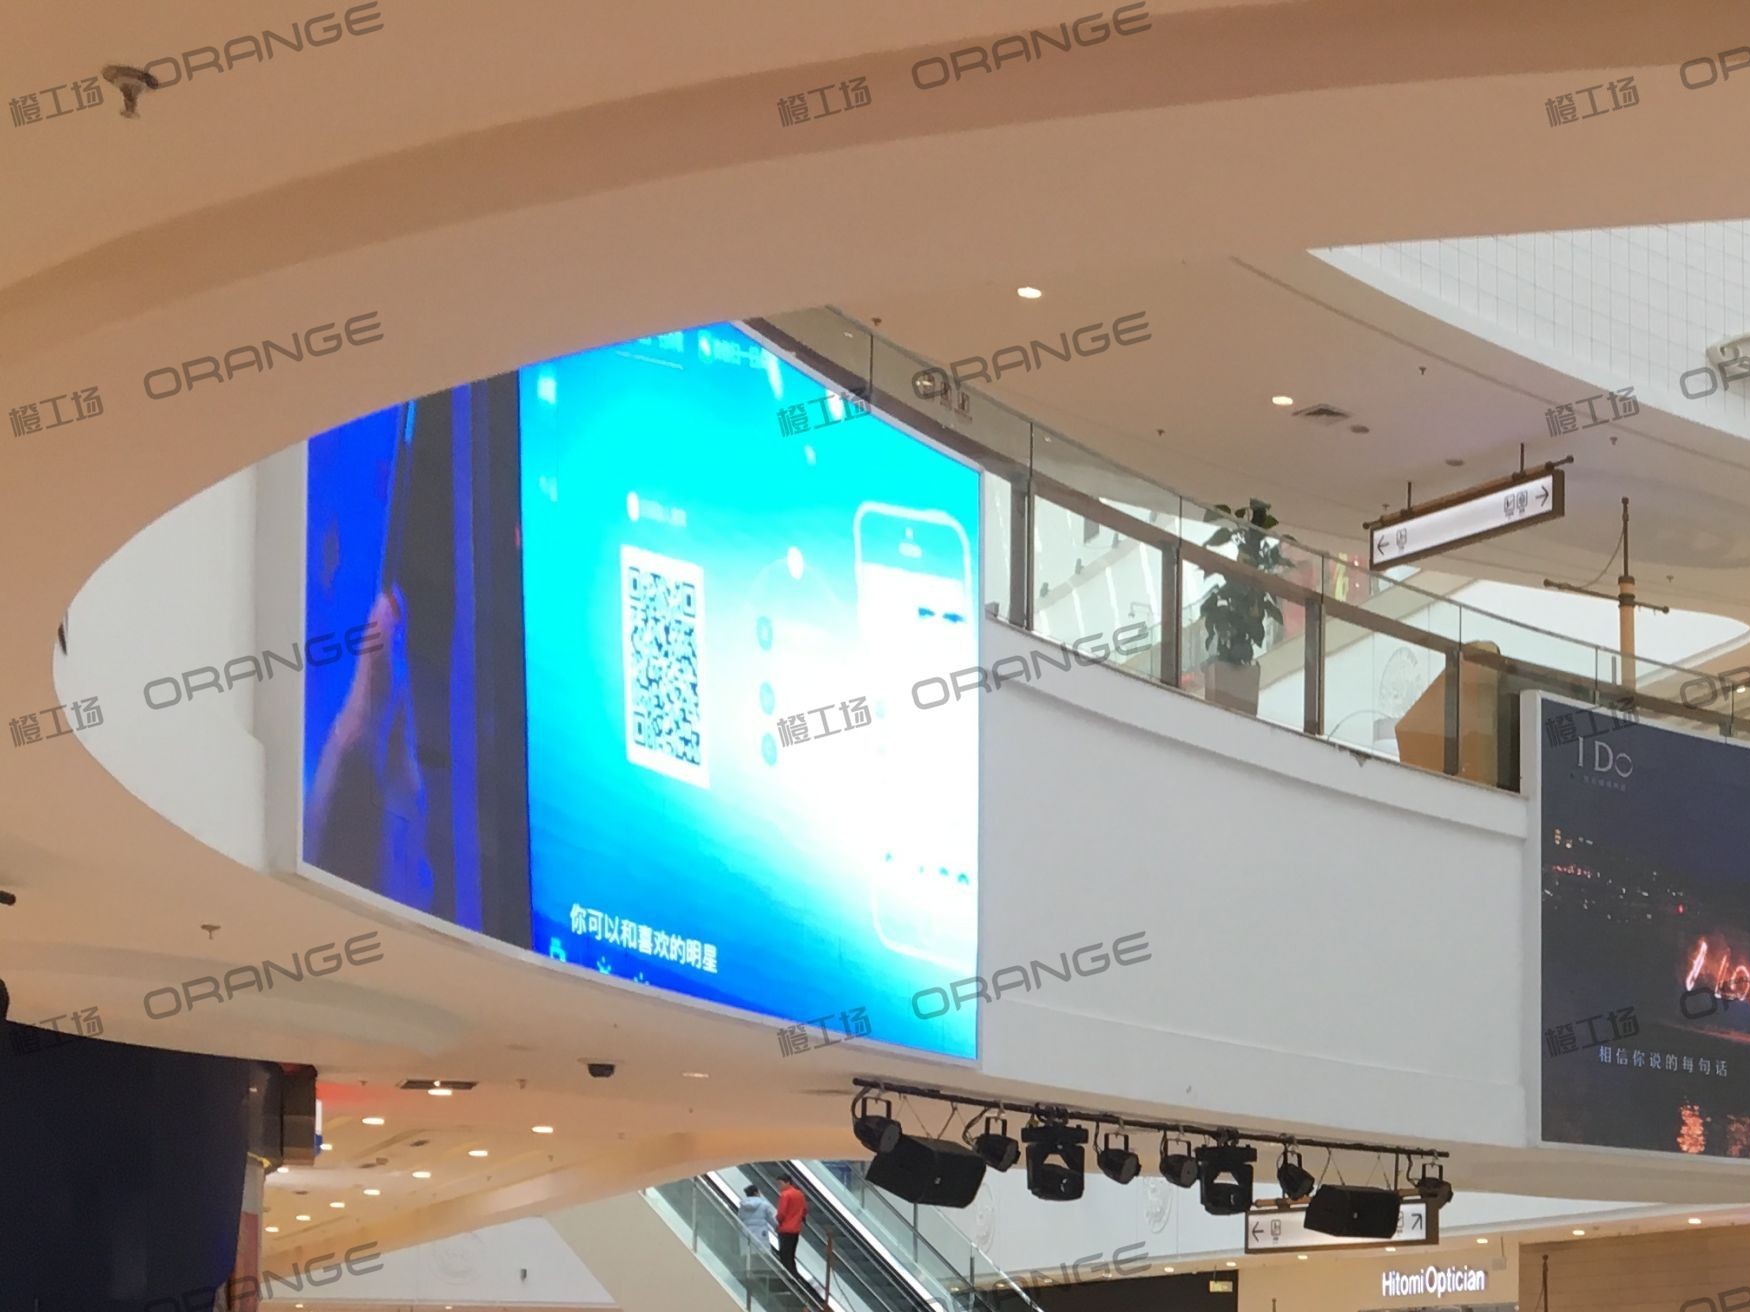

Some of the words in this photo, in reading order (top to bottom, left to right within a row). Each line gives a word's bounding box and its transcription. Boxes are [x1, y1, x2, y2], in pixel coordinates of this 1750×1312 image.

[570, 903, 718, 974] 你可以和喜欢的明星
[1599, 1045, 1728, 1077] 相信你说的每句话
